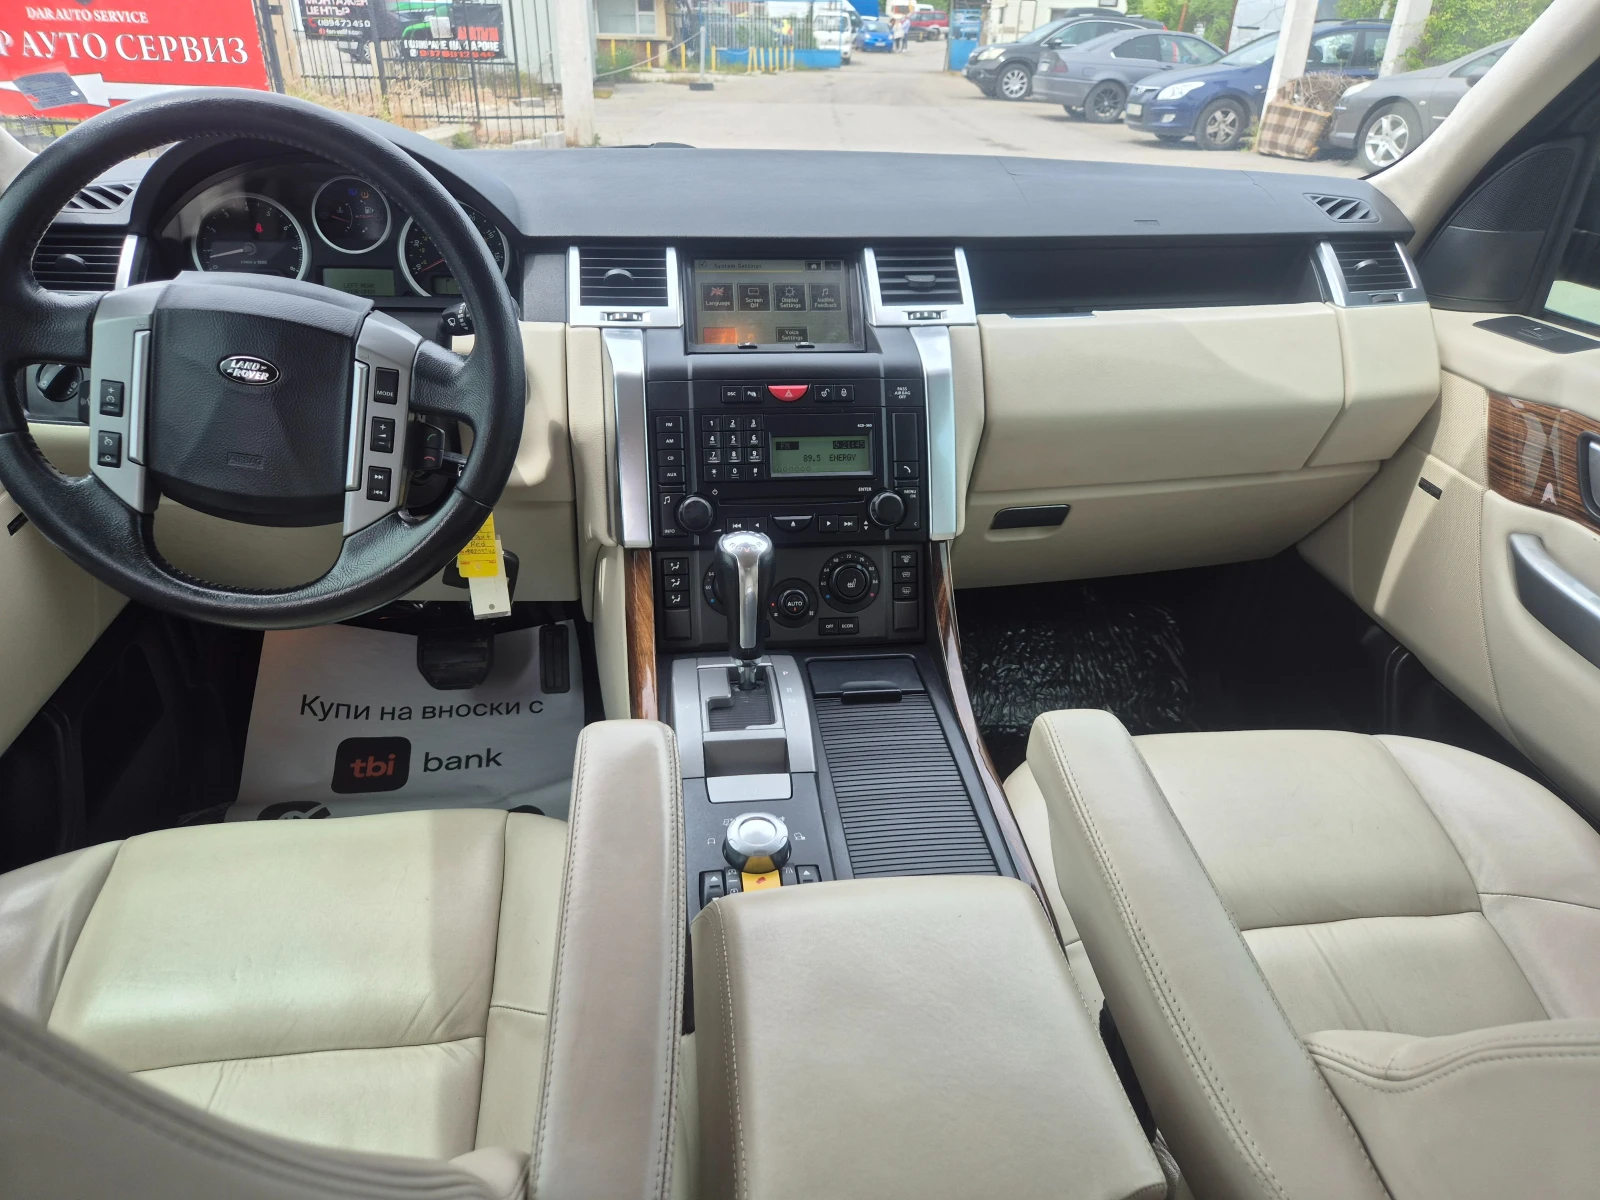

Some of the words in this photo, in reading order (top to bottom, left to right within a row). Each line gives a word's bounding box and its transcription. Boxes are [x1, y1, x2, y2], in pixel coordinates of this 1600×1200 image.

[25, 6, 55, 20] DAR
[56, 9, 92, 22] AUTO
[94, 10, 148, 24] SERVICE
[22, 31, 108, 60] АУТО
[115, 34, 248, 64] СЕРВИЗ
[230, 360, 260, 370] LAND
[232, 369, 269, 380] ROVER
[830, 454, 856, 462] ENERGY
[300, 694, 370, 722] Купи
[380, 704, 412, 721] на
[422, 701, 520, 720] вноски
[530, 699, 544, 714] с
[350, 754, 396, 778] tbi
[424, 748, 503, 773] bank
